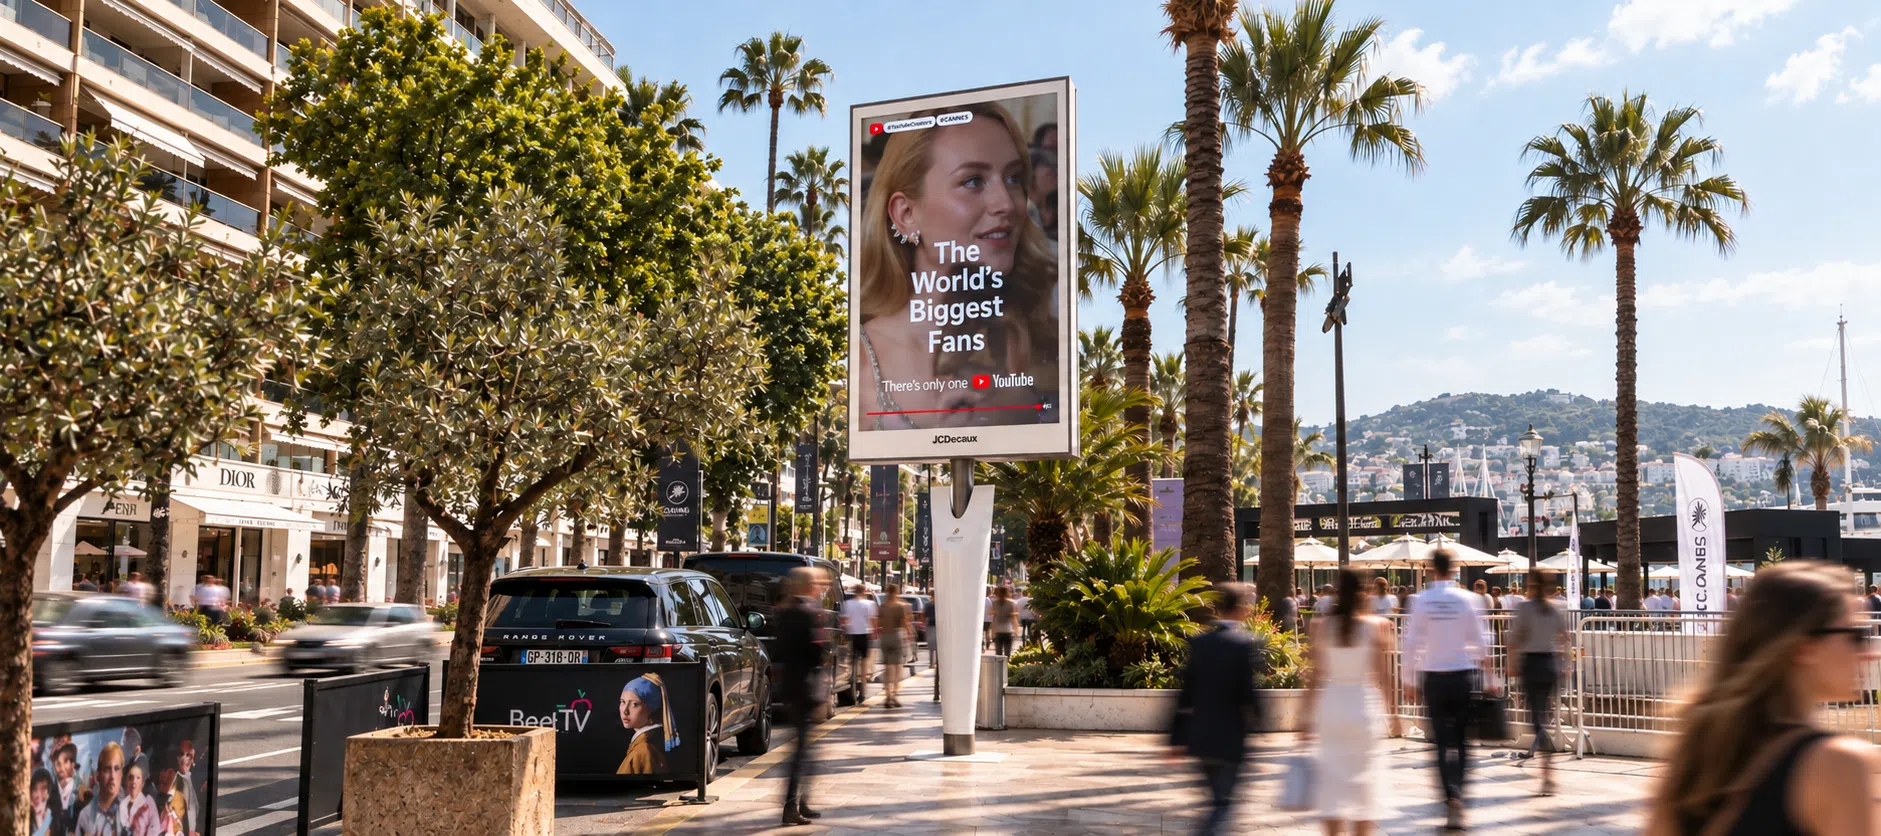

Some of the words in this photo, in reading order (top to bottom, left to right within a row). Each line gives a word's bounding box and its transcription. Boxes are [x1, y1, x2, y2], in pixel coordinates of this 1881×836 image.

[933, 240, 980, 264] The
[911, 265, 1004, 295] World’s
[910, 296, 1004, 327] Biggest
[928, 330, 985, 353] Fans
[881, 379, 921, 393] There's
[922, 378, 946, 393] only
[947, 379, 969, 390] one
[992, 372, 1034, 388] YouTube
[932, 434, 978, 444] JCDecaux
[220, 467, 256, 489] DIOR
